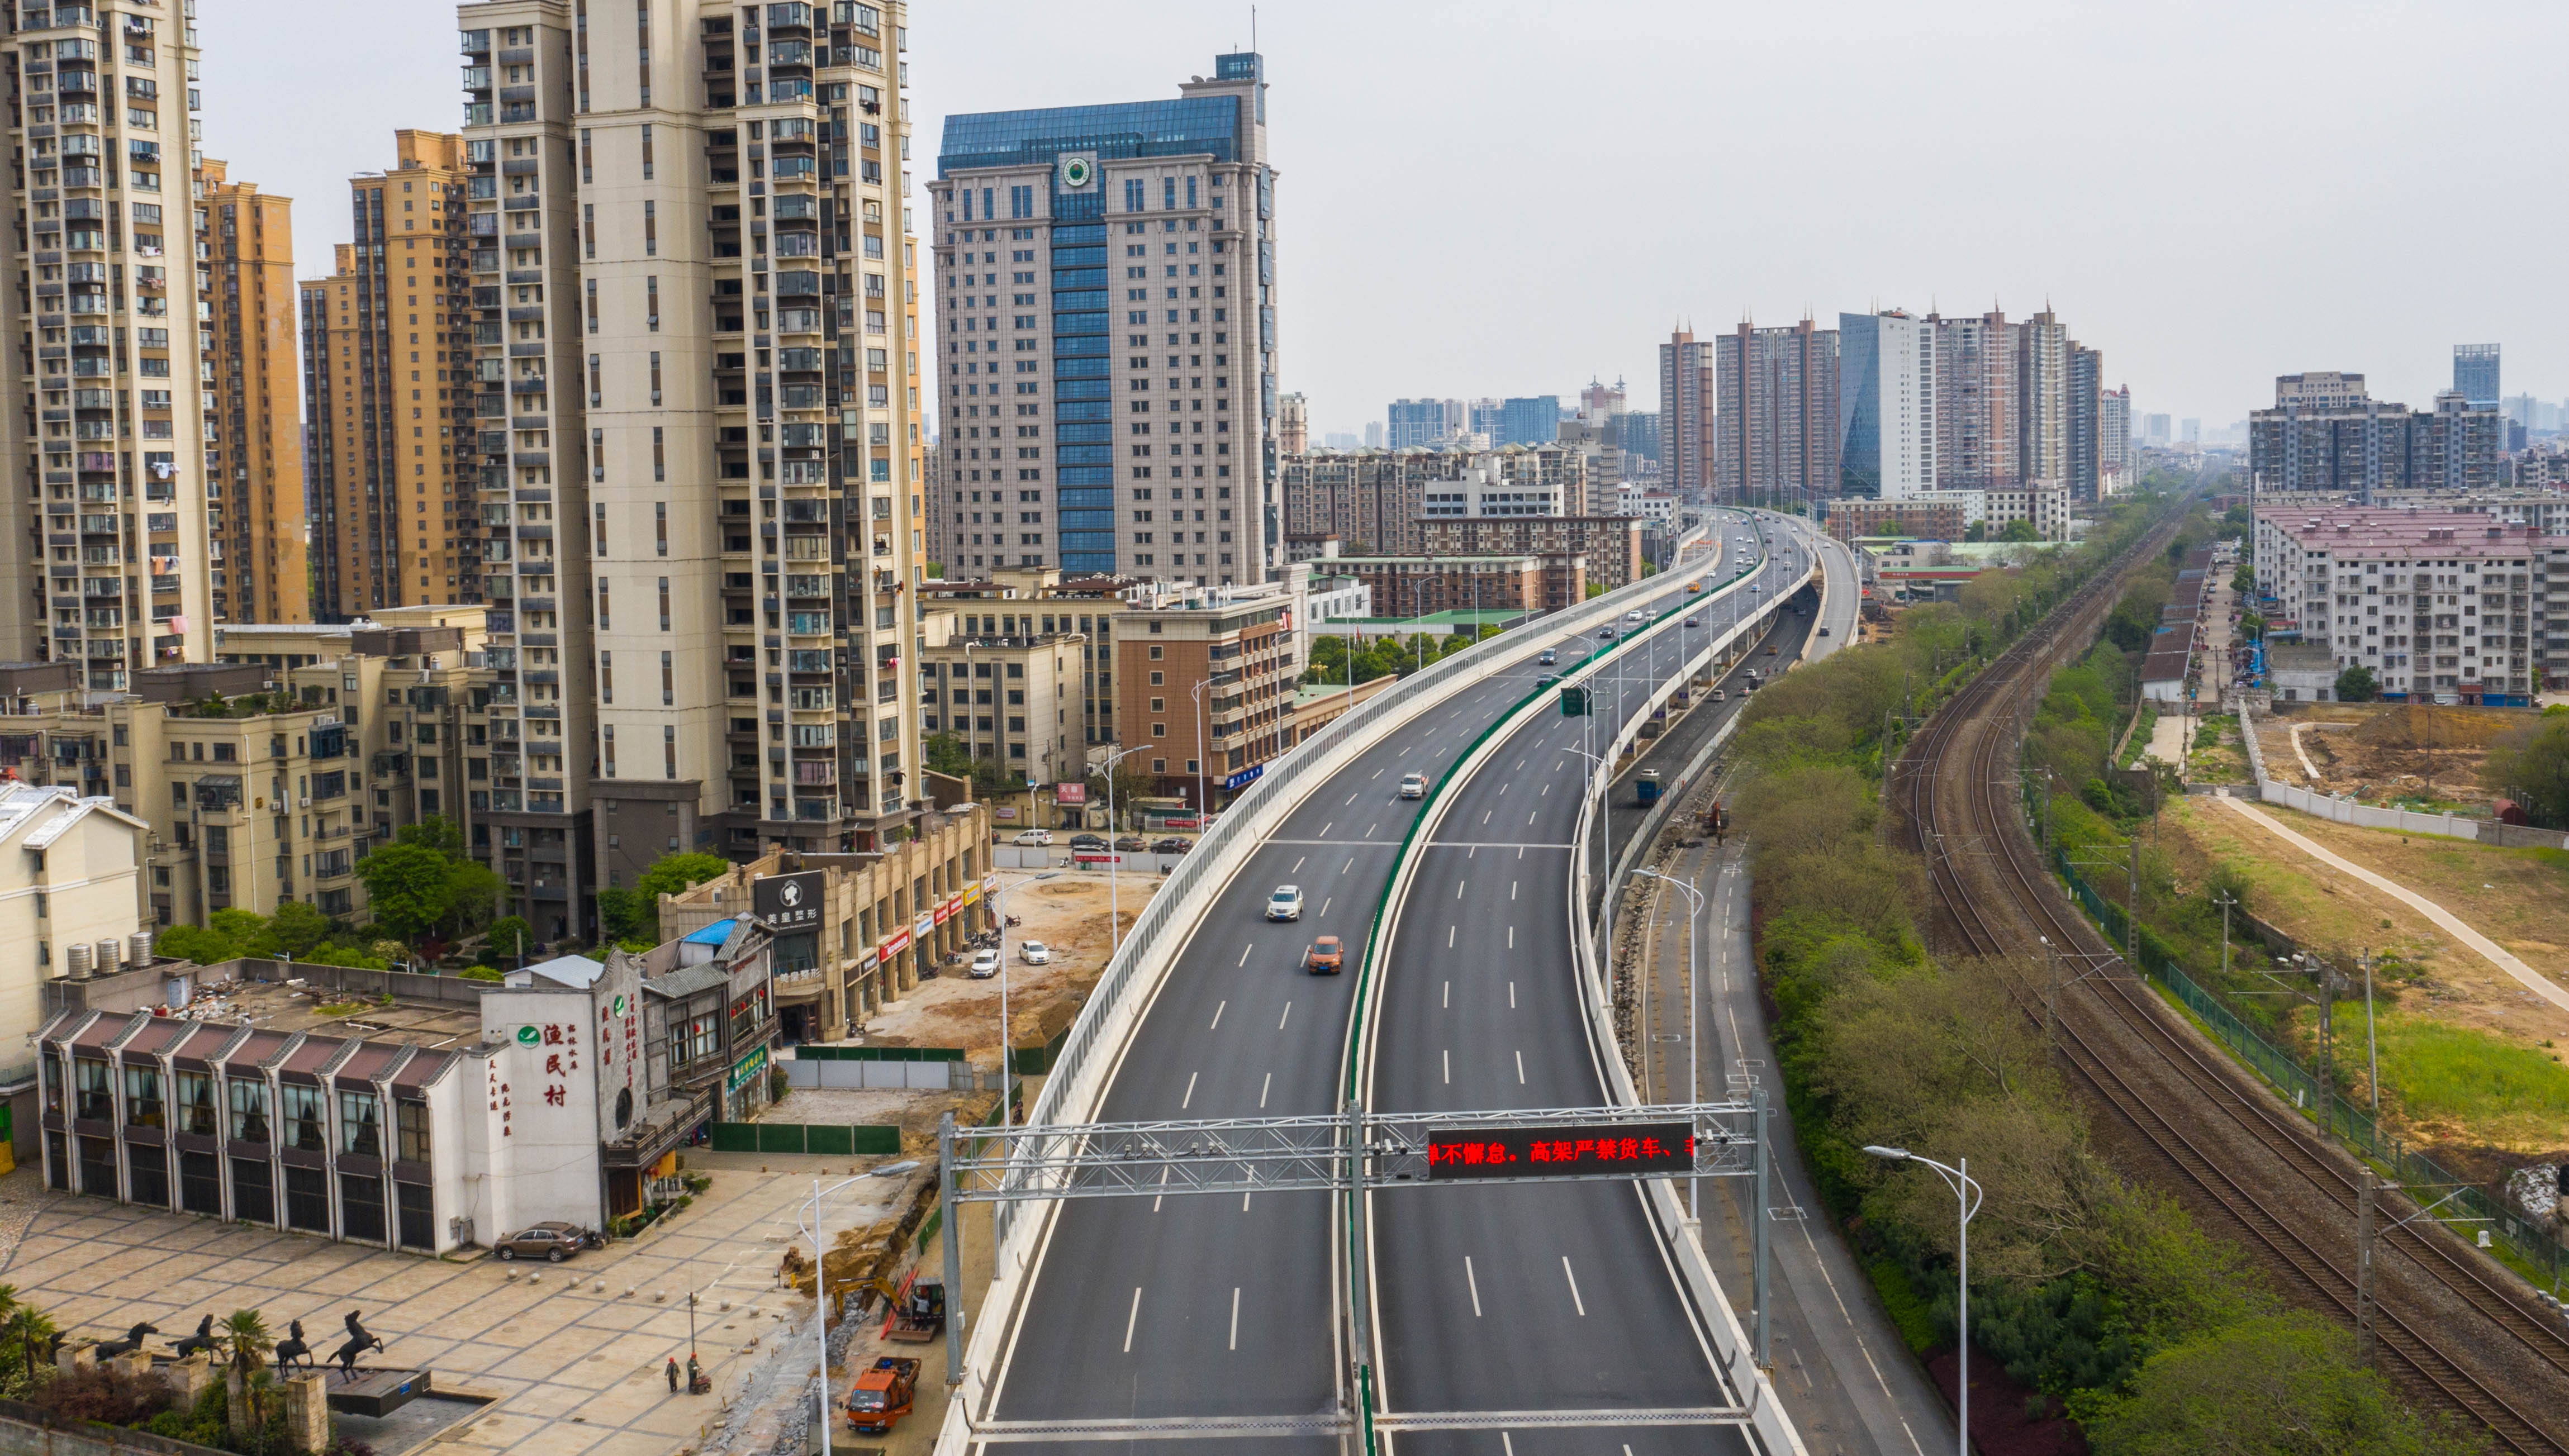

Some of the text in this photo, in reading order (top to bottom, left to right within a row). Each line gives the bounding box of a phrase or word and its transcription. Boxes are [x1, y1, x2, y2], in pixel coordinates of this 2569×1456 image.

[767, 908, 817, 925] 美皇整形
[780, 967, 821, 983] 美皇整形
[544, 1024, 566, 1107] 渔民村
